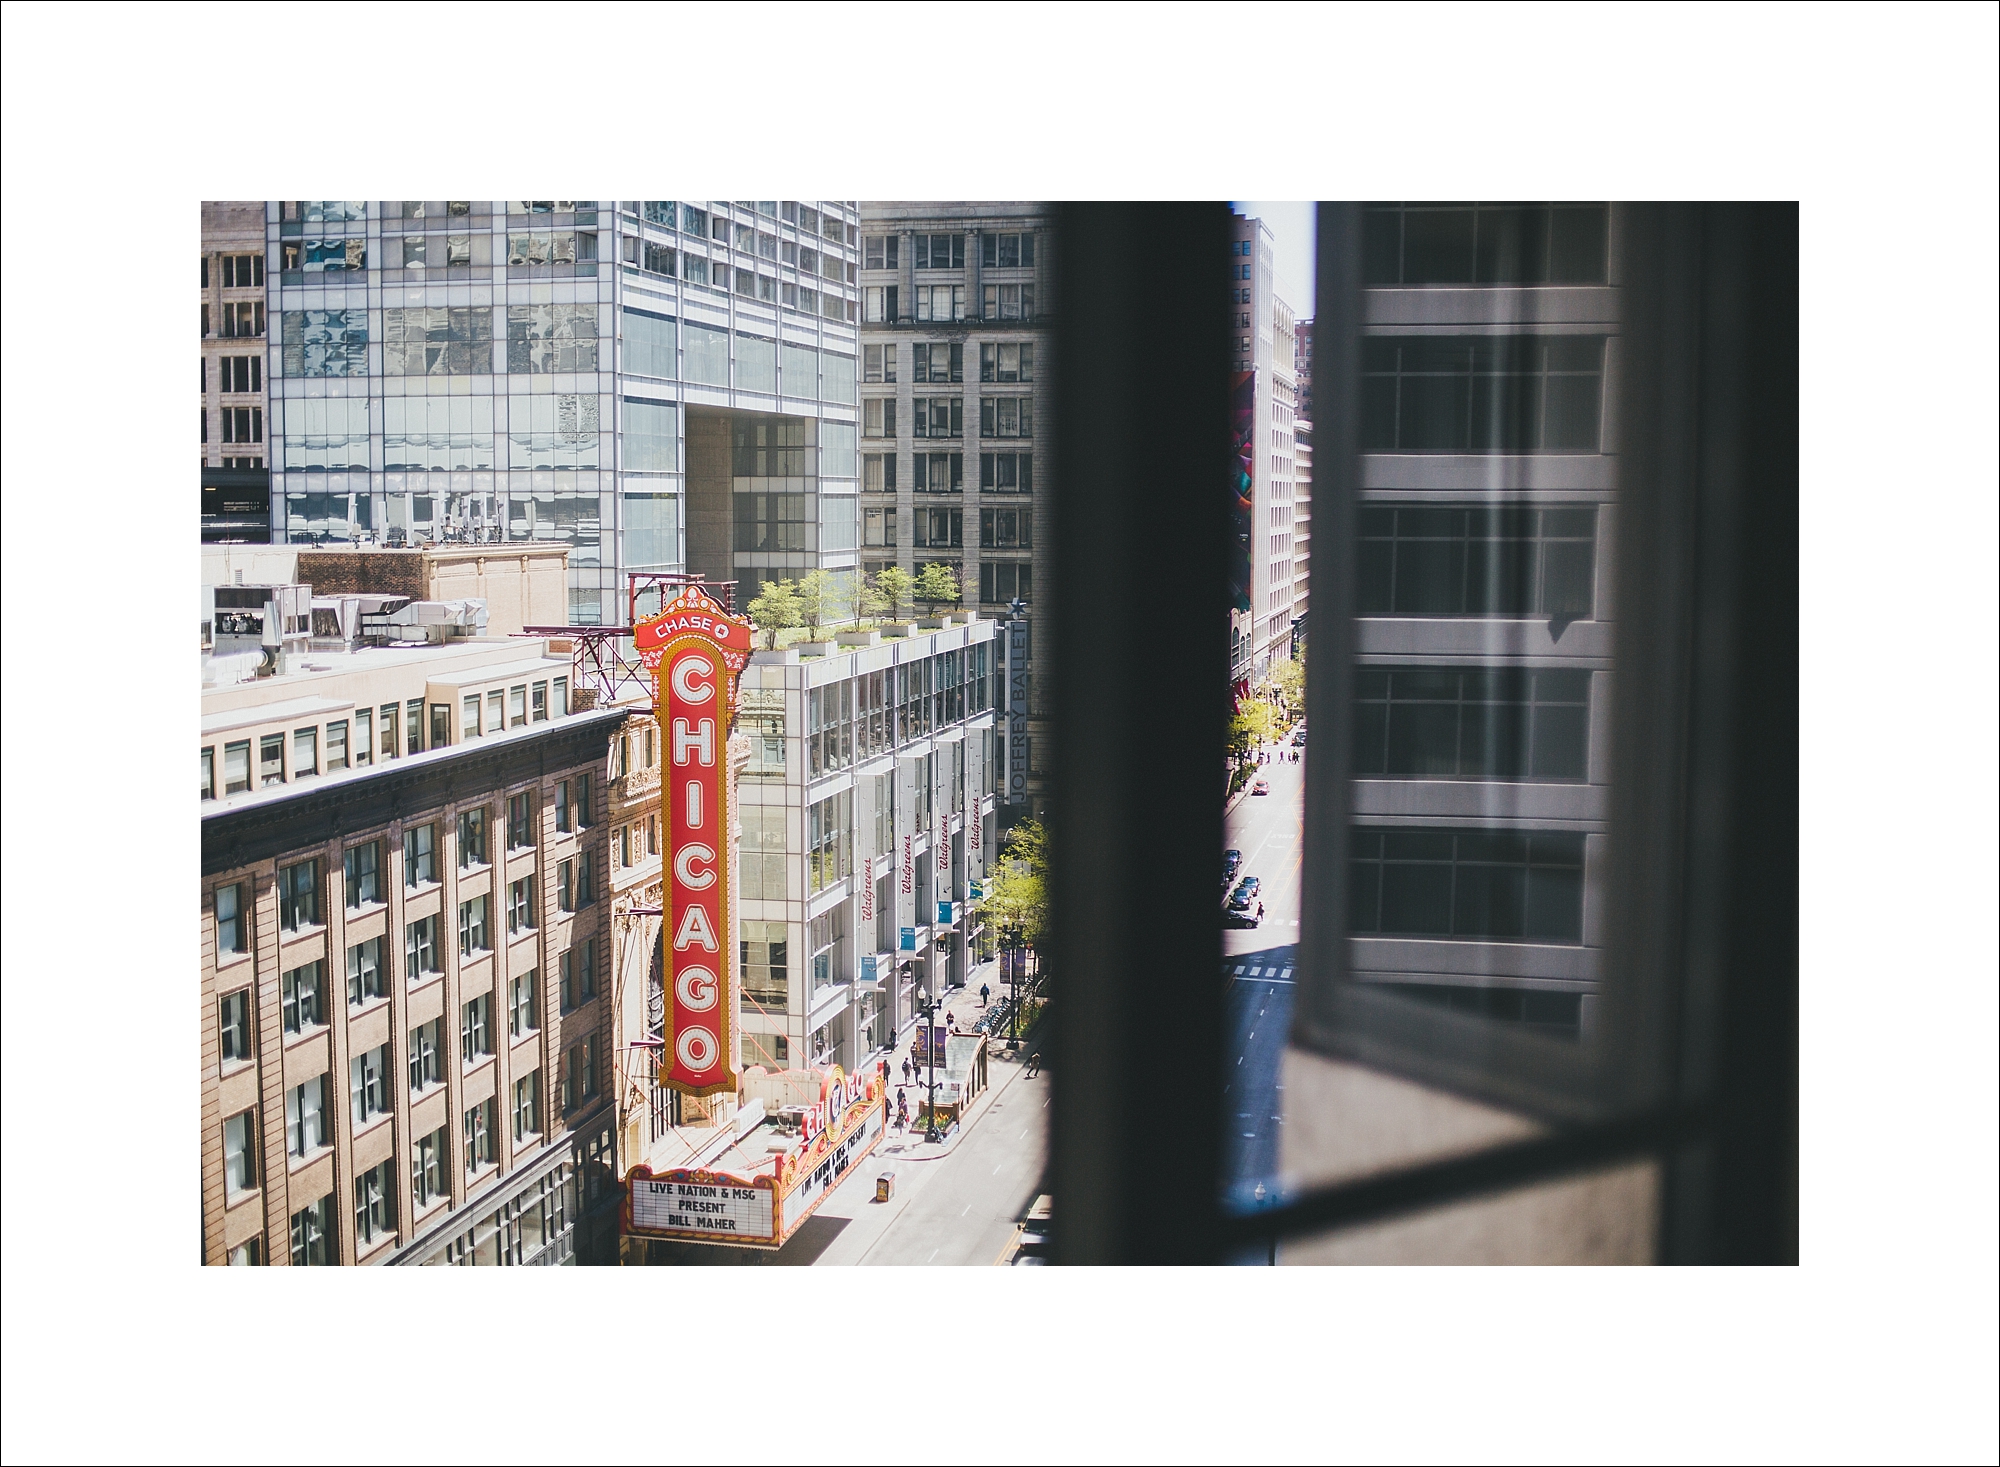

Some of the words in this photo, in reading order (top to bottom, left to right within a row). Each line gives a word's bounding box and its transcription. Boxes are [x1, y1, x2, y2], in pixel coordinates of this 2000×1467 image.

[655, 616, 712, 638] CHASE
[1011, 624, 1026, 701] BALLET
[1011, 711, 1026, 801] JOFFREY
[939, 814, 953, 870] Walgreens
[971, 797, 984, 850] Walgreens
[671, 655, 720, 1073] CHICAGO
[863, 857, 876, 921] Walgreens
[902, 834, 915, 895] Walgreens
[650, 1183, 673, 1194] LIVE
[678, 1185, 717, 1198] NATION
[721, 1188, 729, 1199] &
[732, 1189, 756, 1200] MSG
[678, 1200, 726, 1214] PRESENT
[668, 1215, 691, 1227] BILL
[697, 1217, 736, 1230] MAHER
